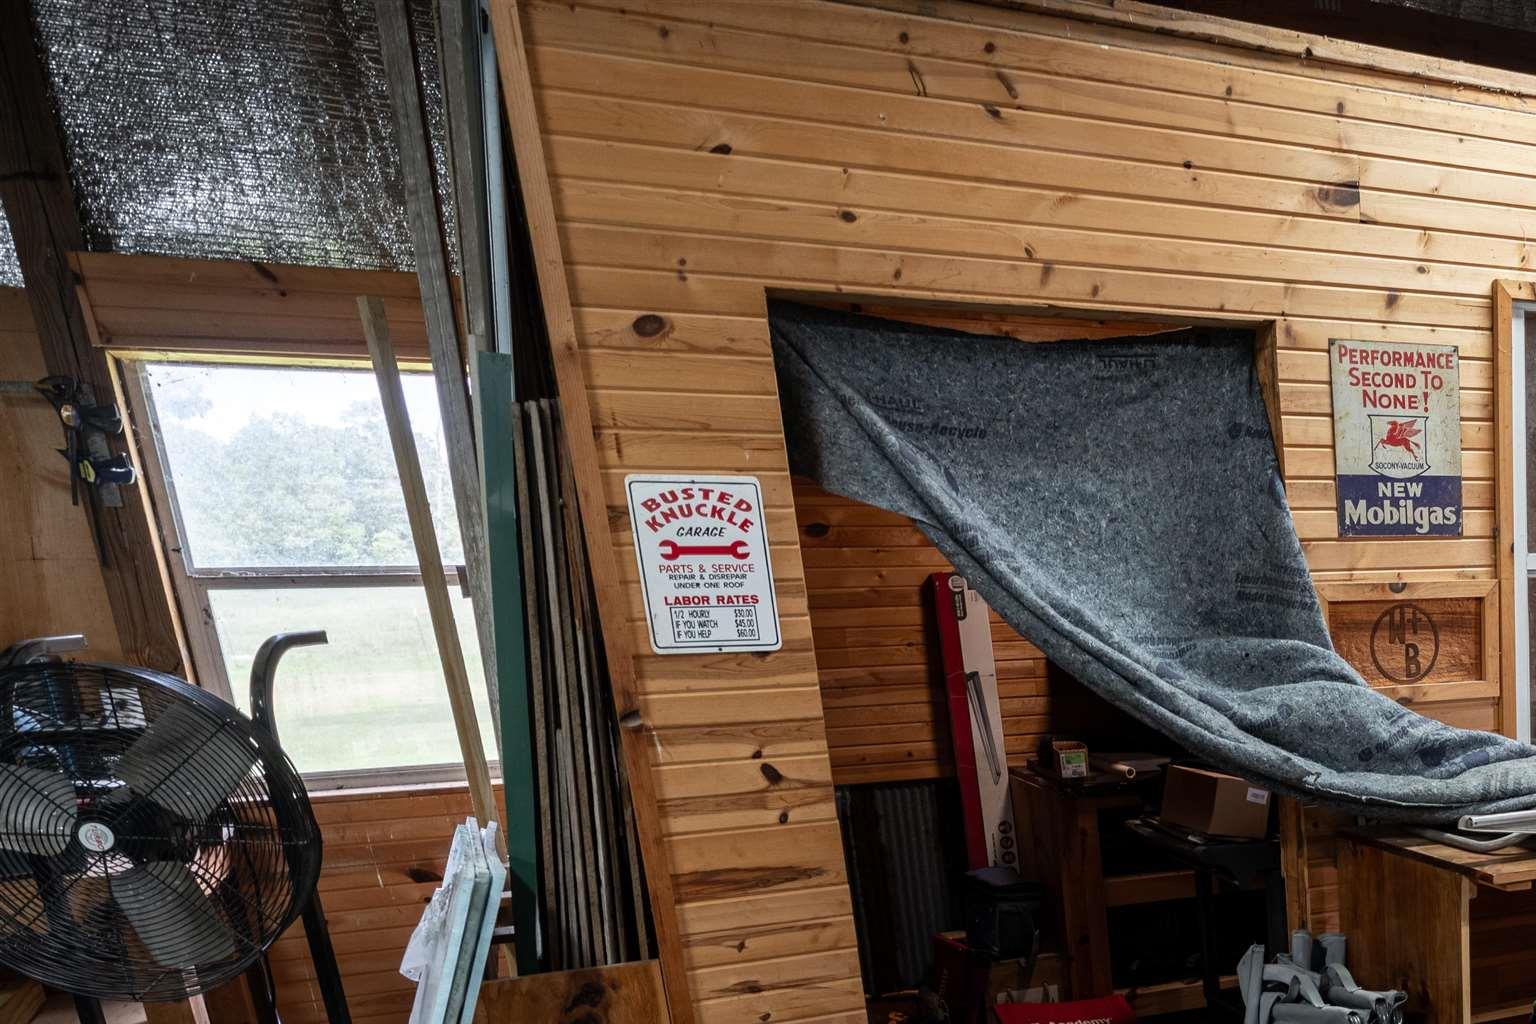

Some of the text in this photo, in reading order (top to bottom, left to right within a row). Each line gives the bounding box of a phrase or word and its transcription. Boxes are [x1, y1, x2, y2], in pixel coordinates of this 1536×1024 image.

[1338, 344, 1454, 369] PERFORMANCE
[1349, 367, 1443, 390] SECOND TO
[1375, 462, 1424, 470] SOCONY-VACUUM
[1378, 482, 1423, 497] NEW
[640, 487, 753, 513] BUSTED
[645, 503, 754, 533] KNUCKLE
[1344, 499, 1457, 534] Mobilgas
[676, 526, 727, 537] GARAGE
[659, 563, 755, 573] PARTS & SERVICE
[664, 595, 760, 606] LABOR RATES
[688, 609, 710, 618] HOURLY
[675, 620, 682, 629] IF
[683, 620, 697, 629] YOU
[699, 619, 718, 628] WATCH
[676, 630, 683, 639] IF
[684, 630, 697, 639] YOU
[697, 629, 712, 639] HELP
